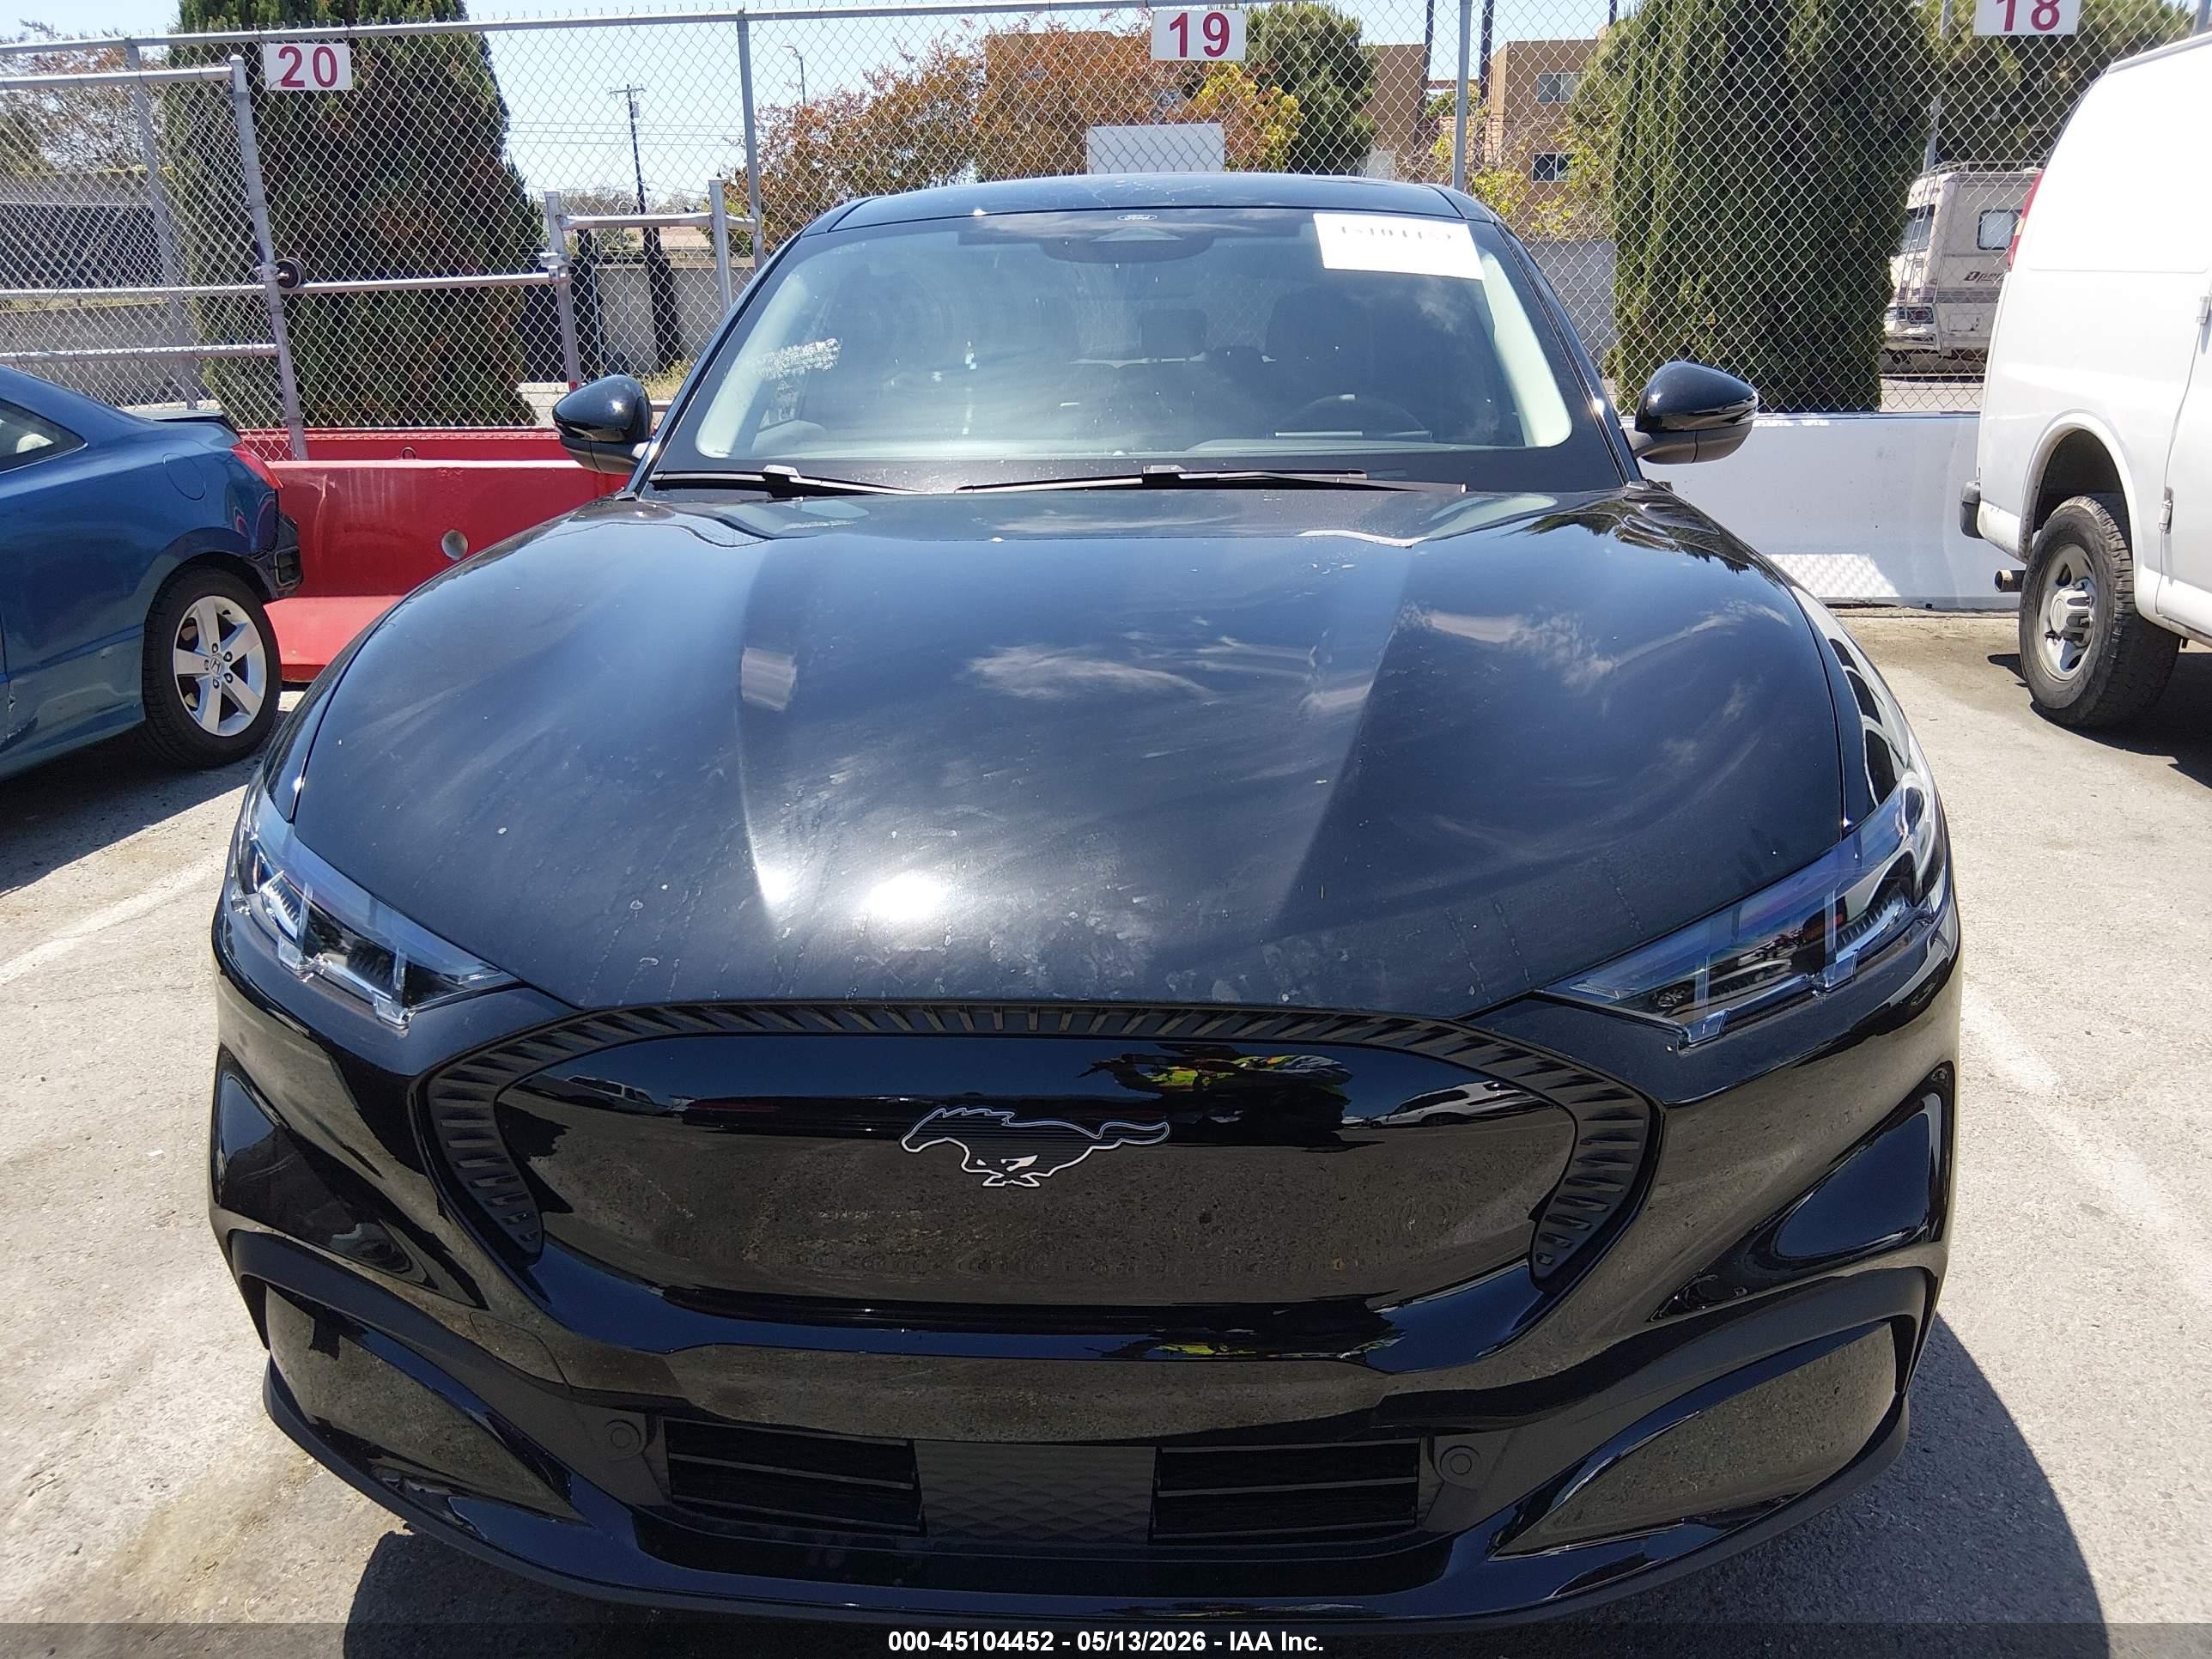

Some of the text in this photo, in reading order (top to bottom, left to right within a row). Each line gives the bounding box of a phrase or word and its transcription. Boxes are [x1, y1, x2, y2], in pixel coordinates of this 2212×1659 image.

[1169, 12, 1231, 58] 19
[1996, 0, 2060, 32] 18
[278, 46, 337, 88] 20
